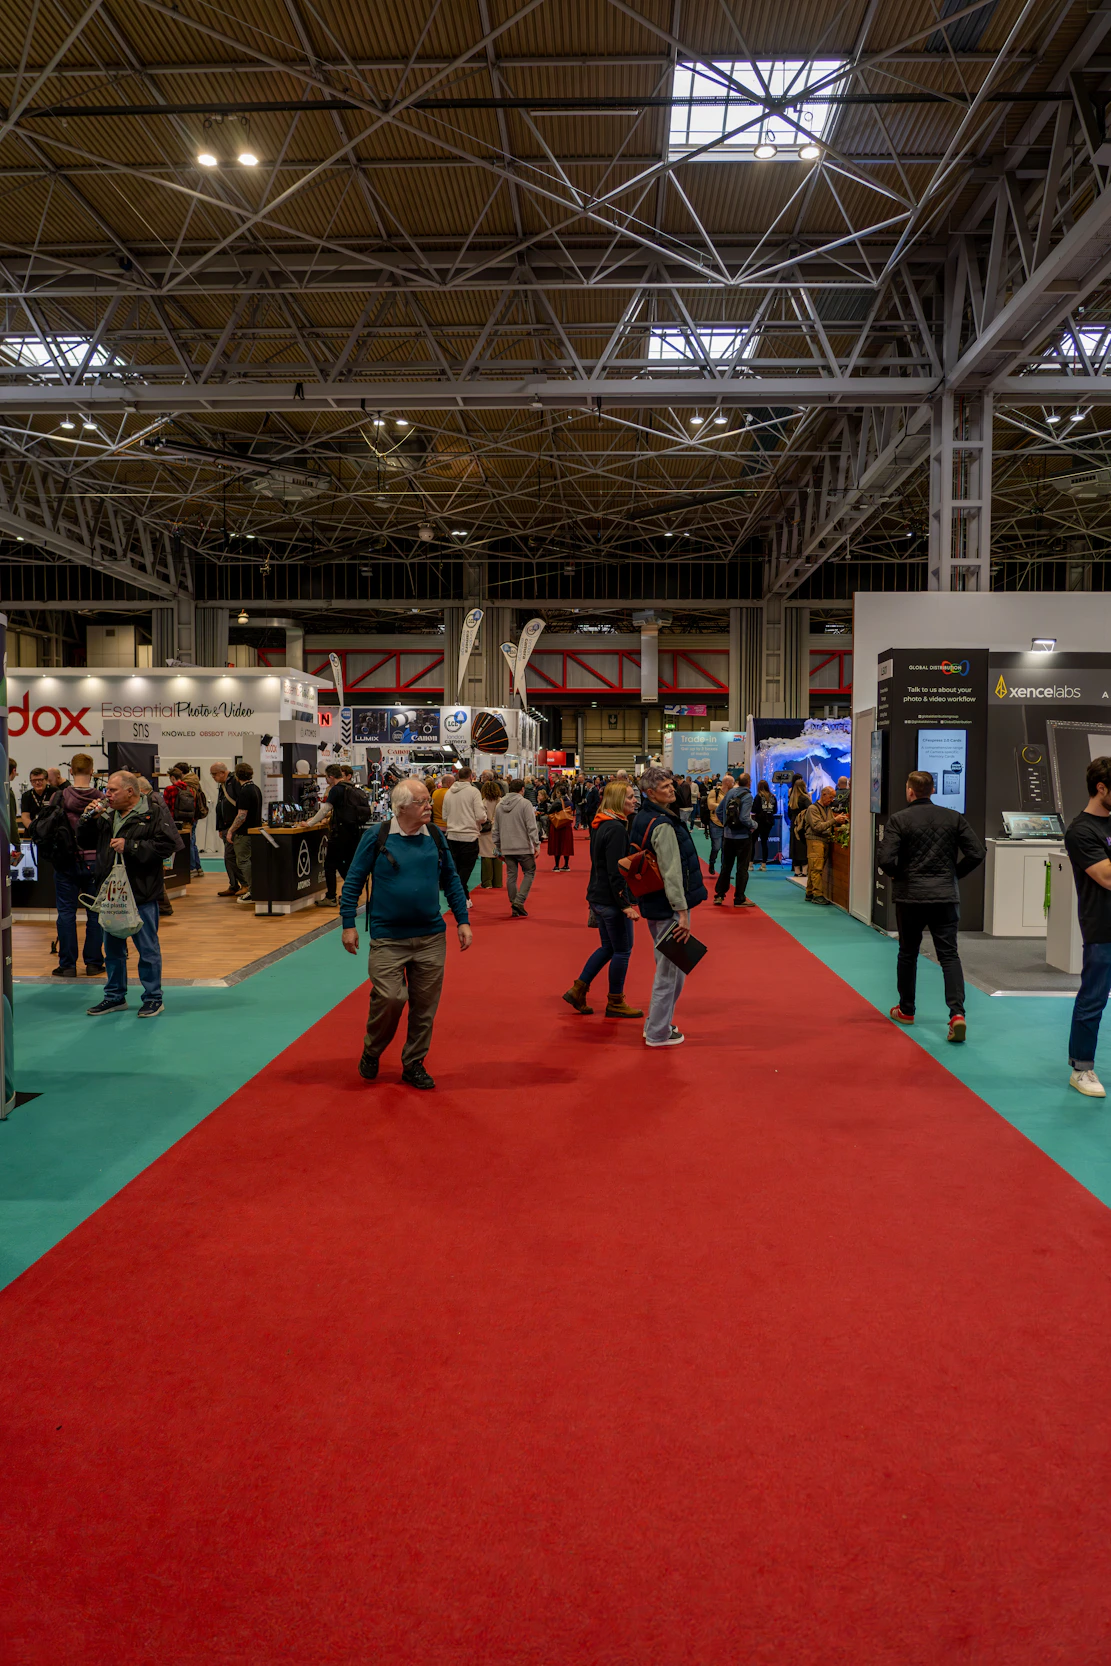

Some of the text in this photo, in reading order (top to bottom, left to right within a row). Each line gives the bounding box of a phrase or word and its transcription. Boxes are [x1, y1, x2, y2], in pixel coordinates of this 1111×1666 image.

[1009, 684, 1081, 699] xencelabs
[1101, 691, 1109, 699] A
[318, 713, 330, 726] N
[161, 730, 196, 738] KNOWLED
[199, 730, 225, 738] OBSBOT
[411, 734, 438, 742] Canon
[355, 734, 379, 743] LUMIX
[681, 735, 717, 743] Trade-in
